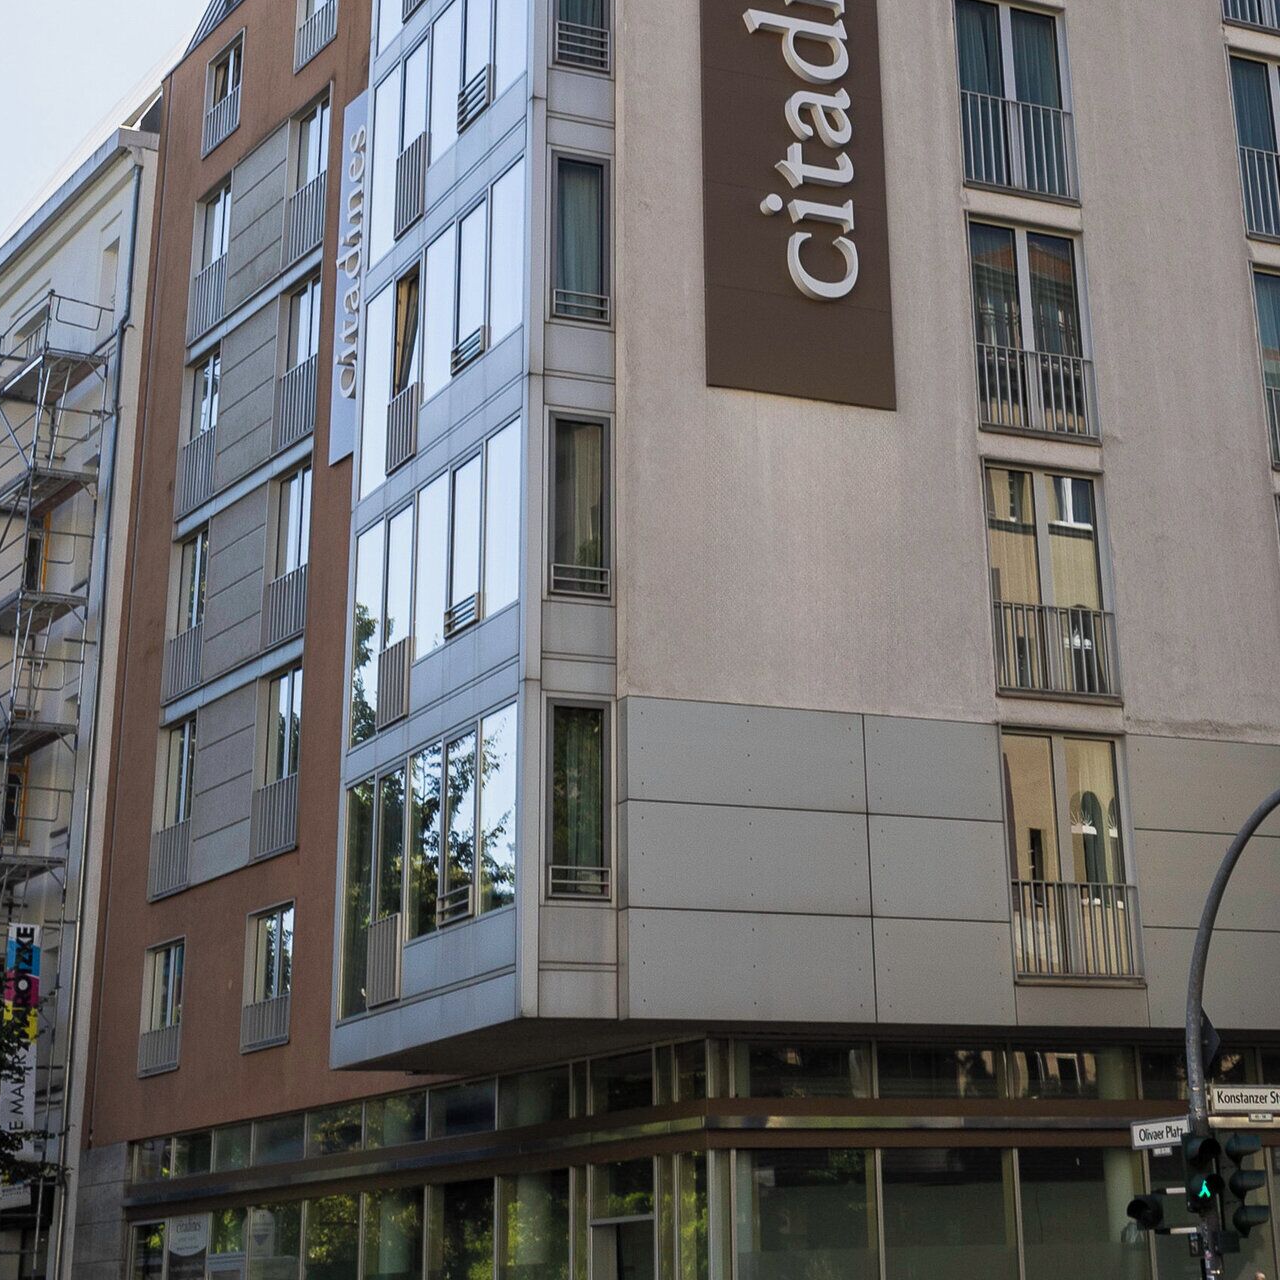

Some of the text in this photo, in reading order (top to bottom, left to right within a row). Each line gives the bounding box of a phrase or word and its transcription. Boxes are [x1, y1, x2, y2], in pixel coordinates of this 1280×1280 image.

[1217, 1091, 1268, 1105] Konstanzer
[1138, 1125, 1184, 1143] Olivaer Platz
